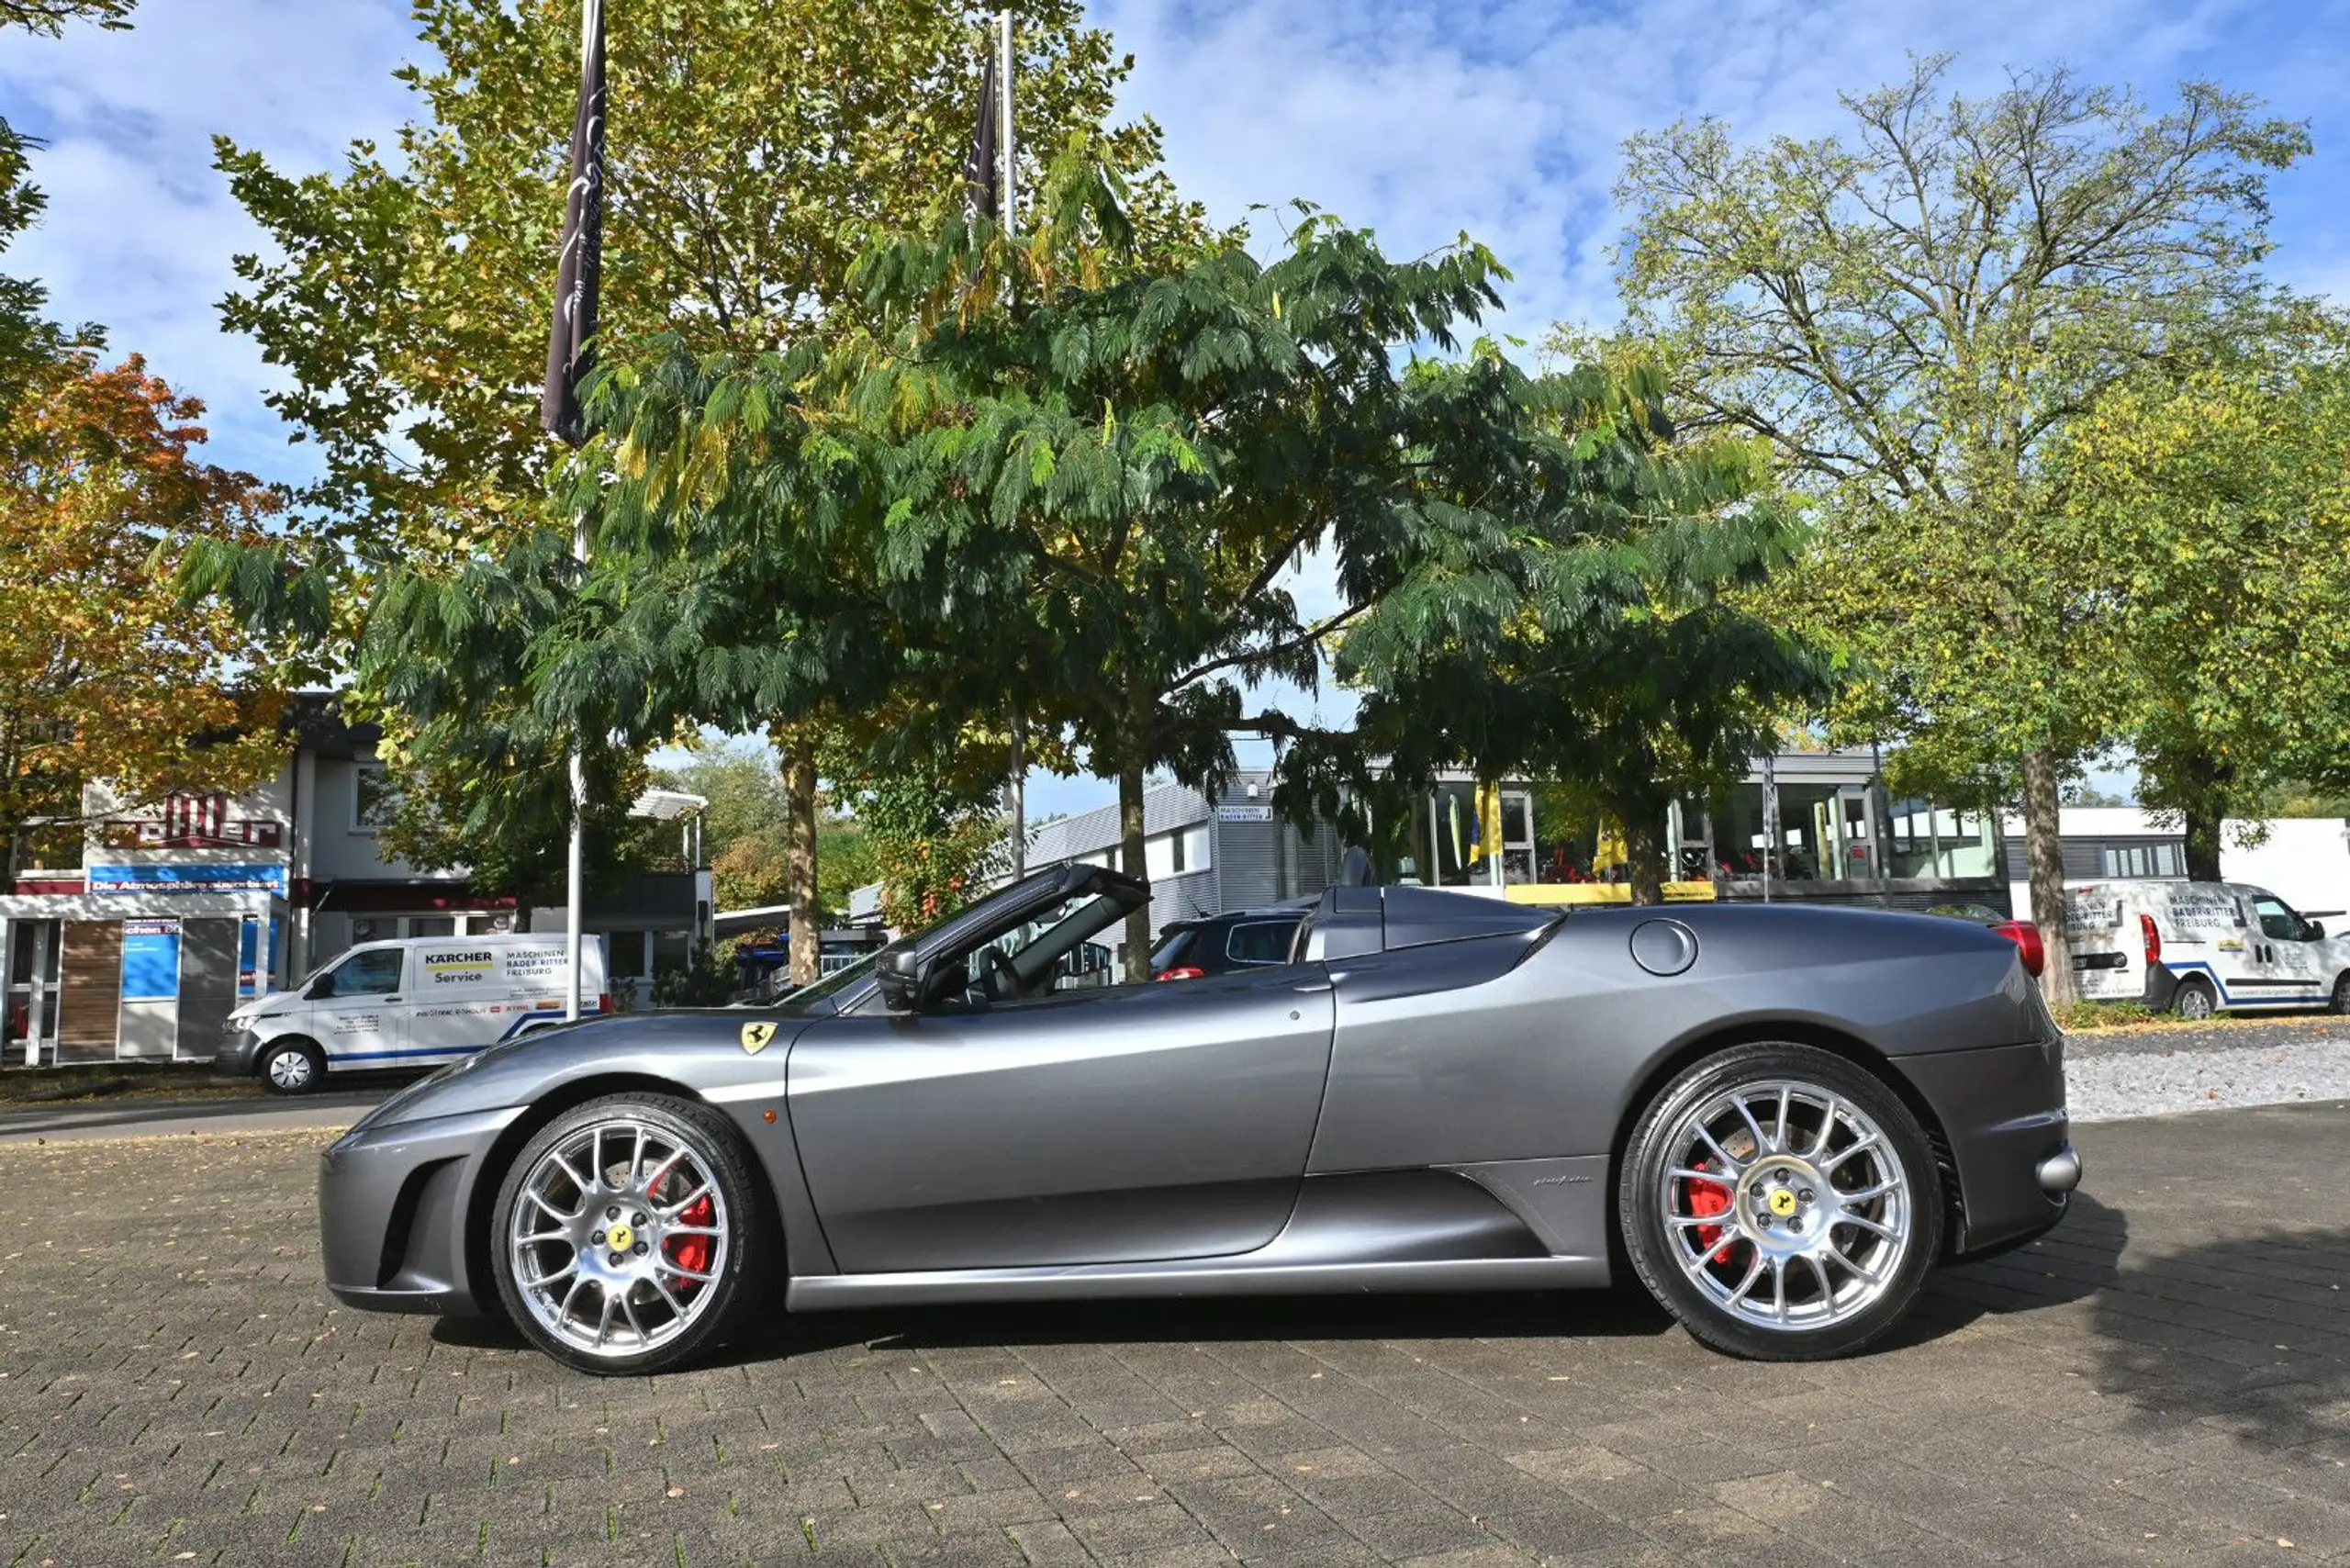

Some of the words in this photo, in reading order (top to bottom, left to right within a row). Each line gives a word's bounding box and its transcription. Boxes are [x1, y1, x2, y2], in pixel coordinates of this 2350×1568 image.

[425, 952, 493, 964] KÄRCHER
[507, 949, 565, 959] MASCHINEN
[434, 971, 483, 983] Service
[507, 968, 552, 977] FREIBURG
